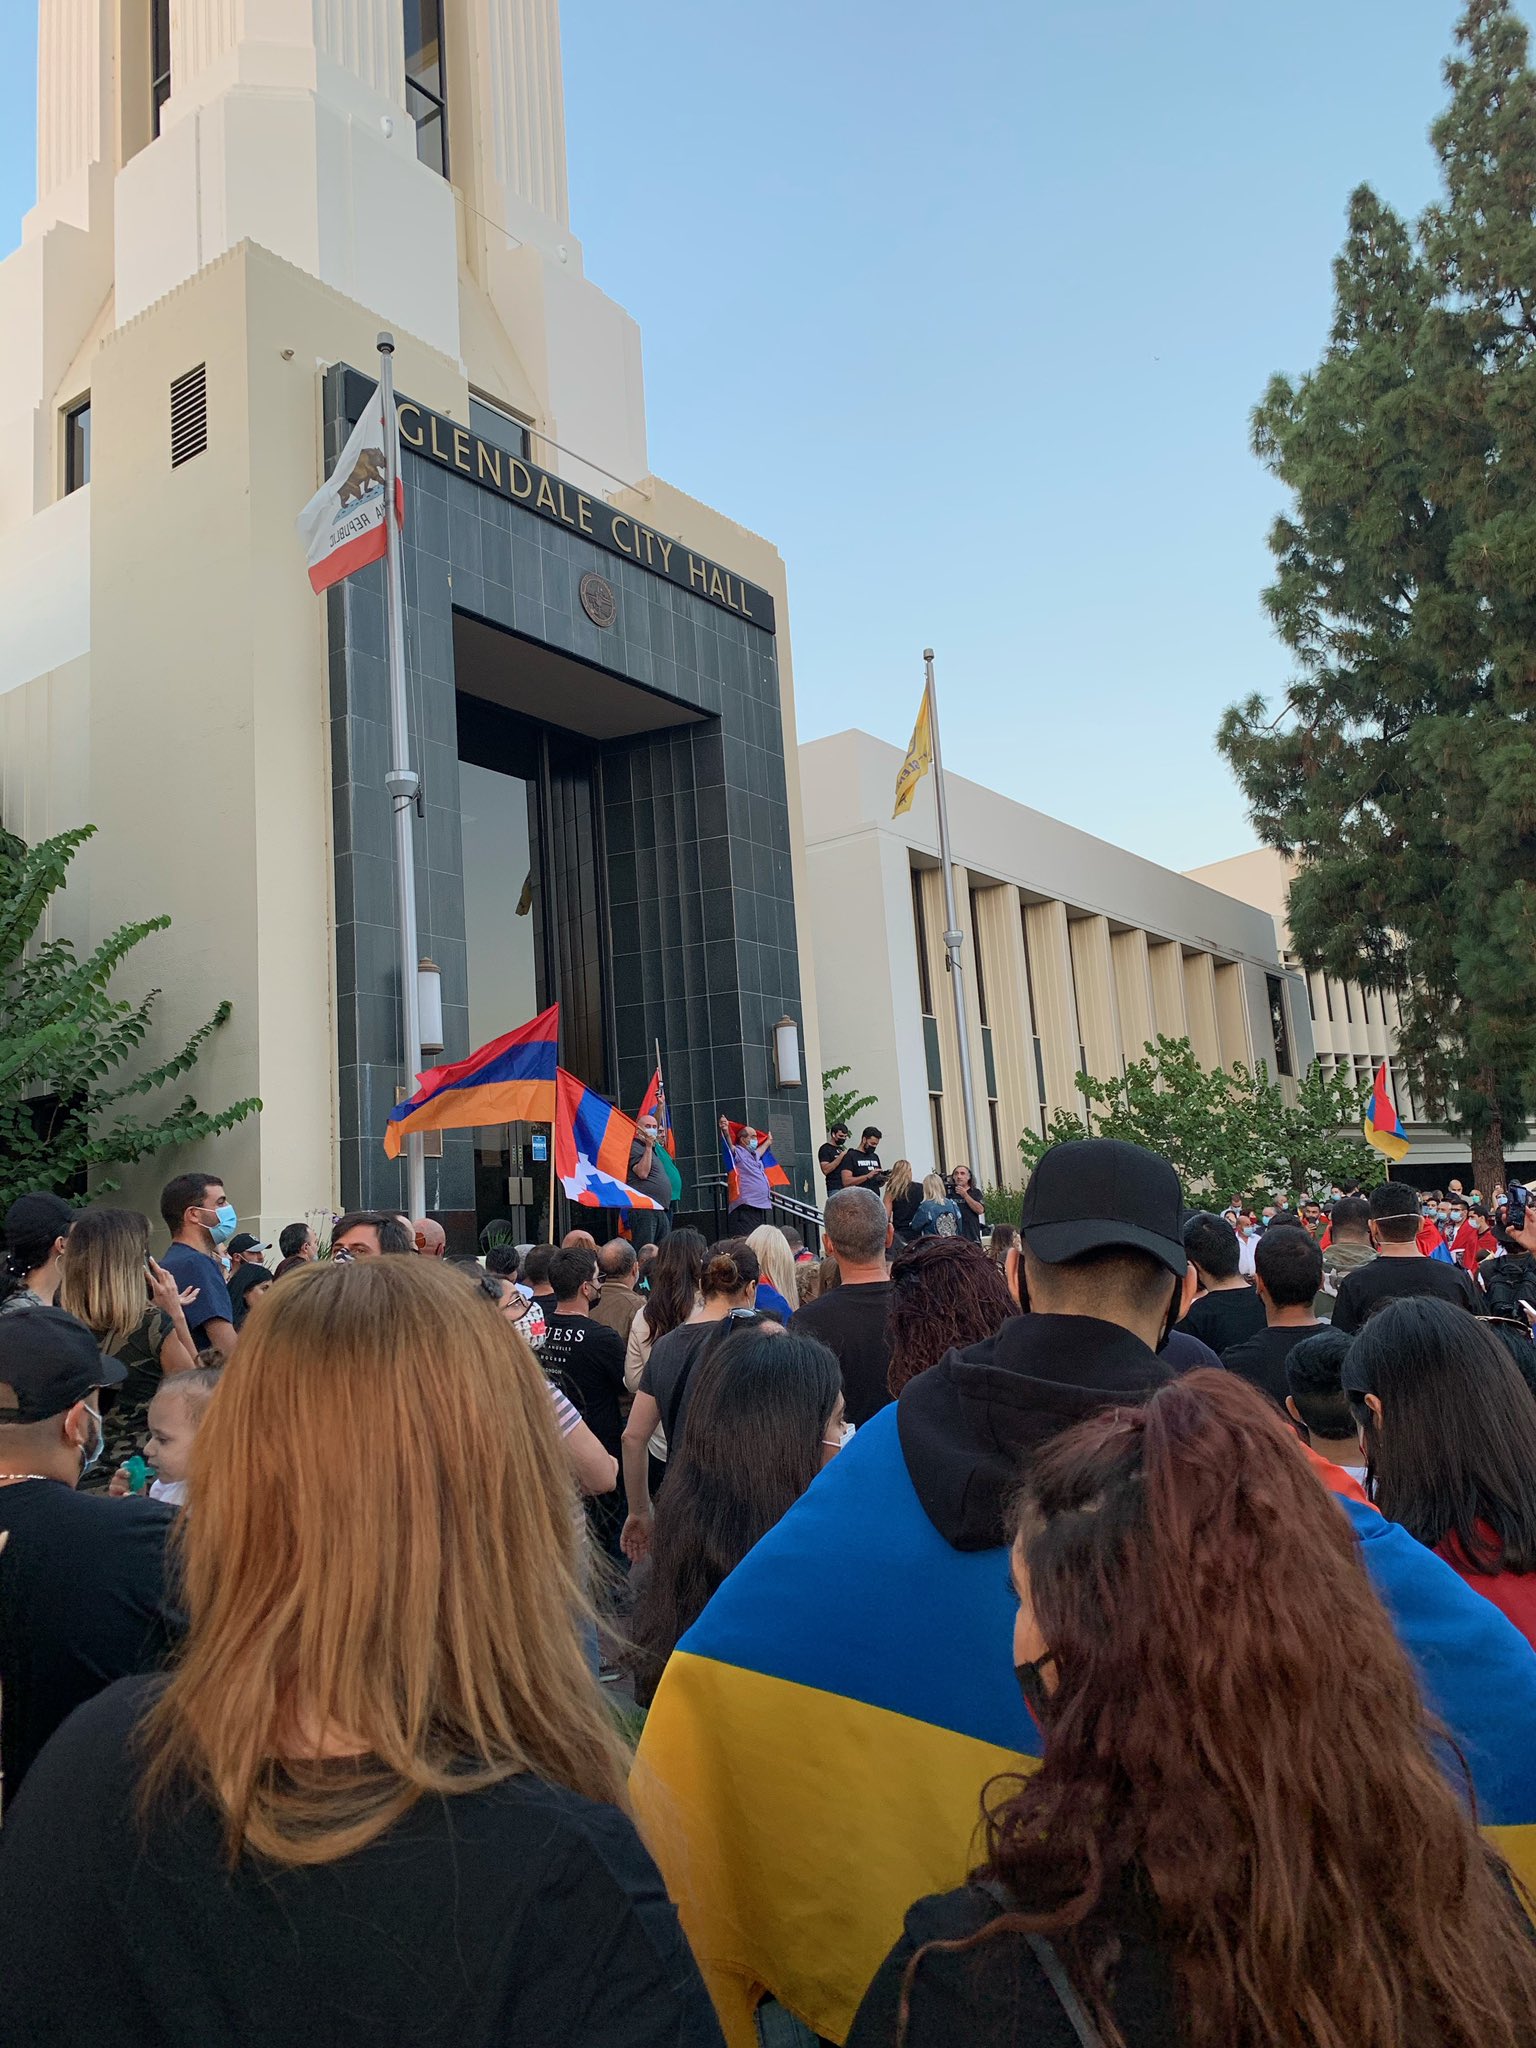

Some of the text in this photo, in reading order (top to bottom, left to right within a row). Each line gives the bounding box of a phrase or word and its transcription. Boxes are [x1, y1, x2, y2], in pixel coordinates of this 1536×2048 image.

[396, 403, 593, 534] GLENDALE
[611, 515, 673, 573] CITY
[688, 554, 753, 617] HALL
[545, 1326, 585, 1342] UESS
